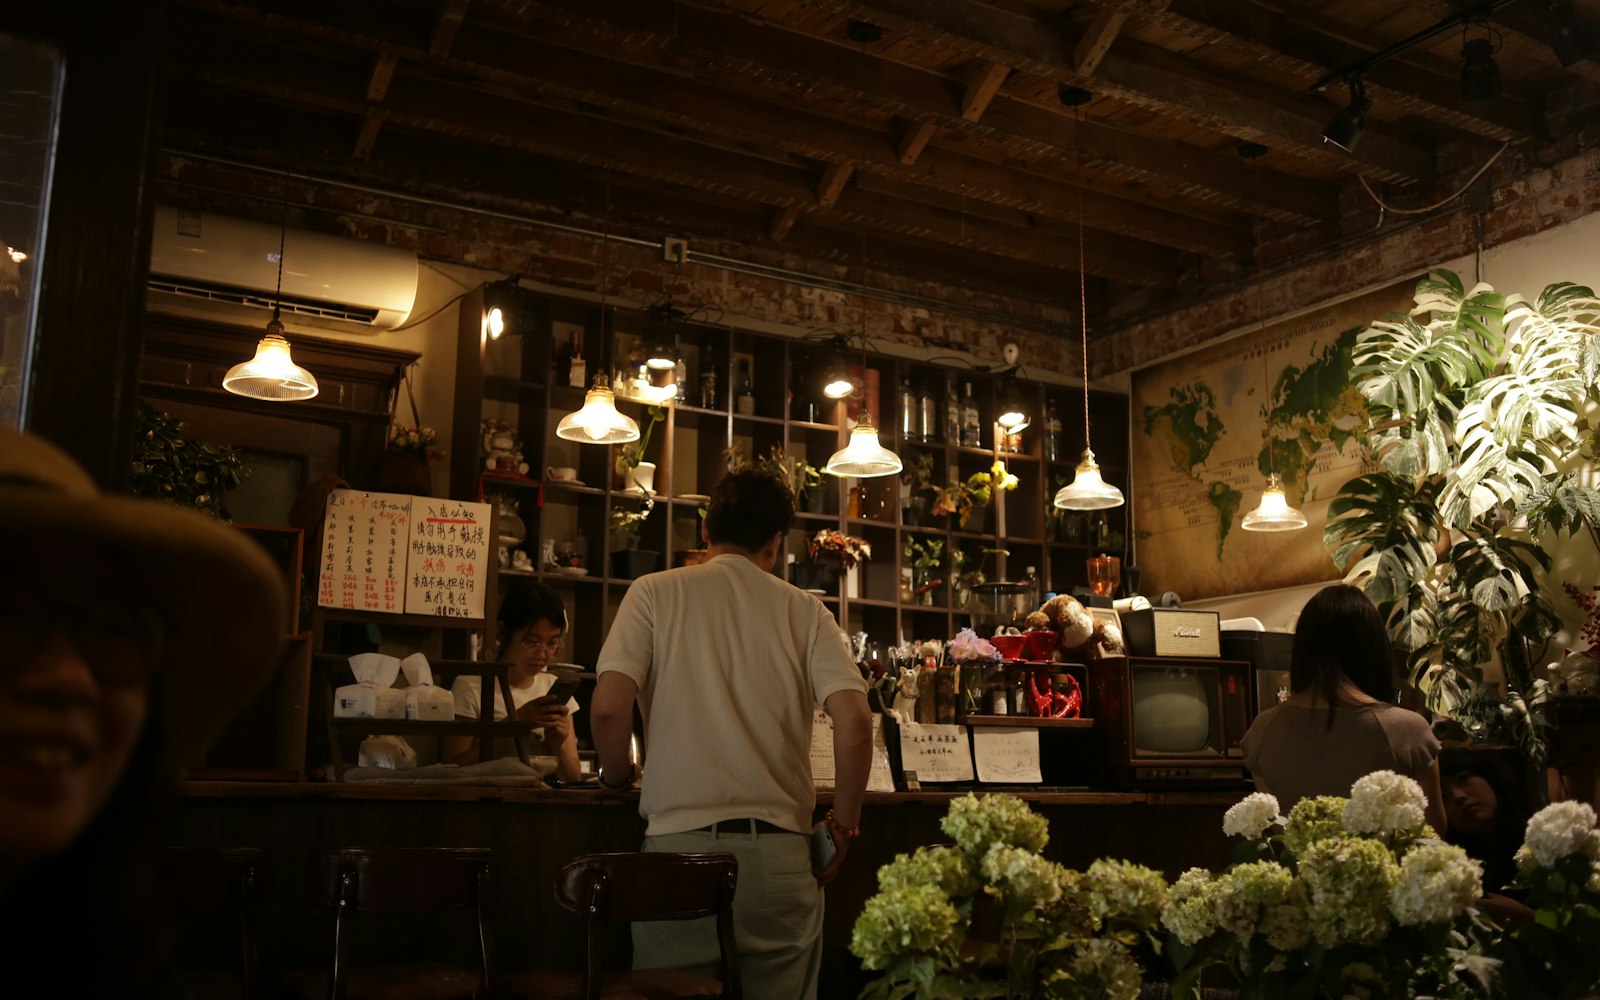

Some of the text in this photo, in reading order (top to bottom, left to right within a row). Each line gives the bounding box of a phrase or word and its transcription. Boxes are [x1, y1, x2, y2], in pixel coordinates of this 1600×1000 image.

[1308, 317, 1336, 333] WORLD
[428, 504, 475, 520] 入店必知
[417, 522, 485, 546] 请勿用手触摸
[412, 540, 476, 560] 用手触摸导致的
[412, 572, 475, 592] 本店不承担任何
[424, 590, 467, 606] 医疗责任
